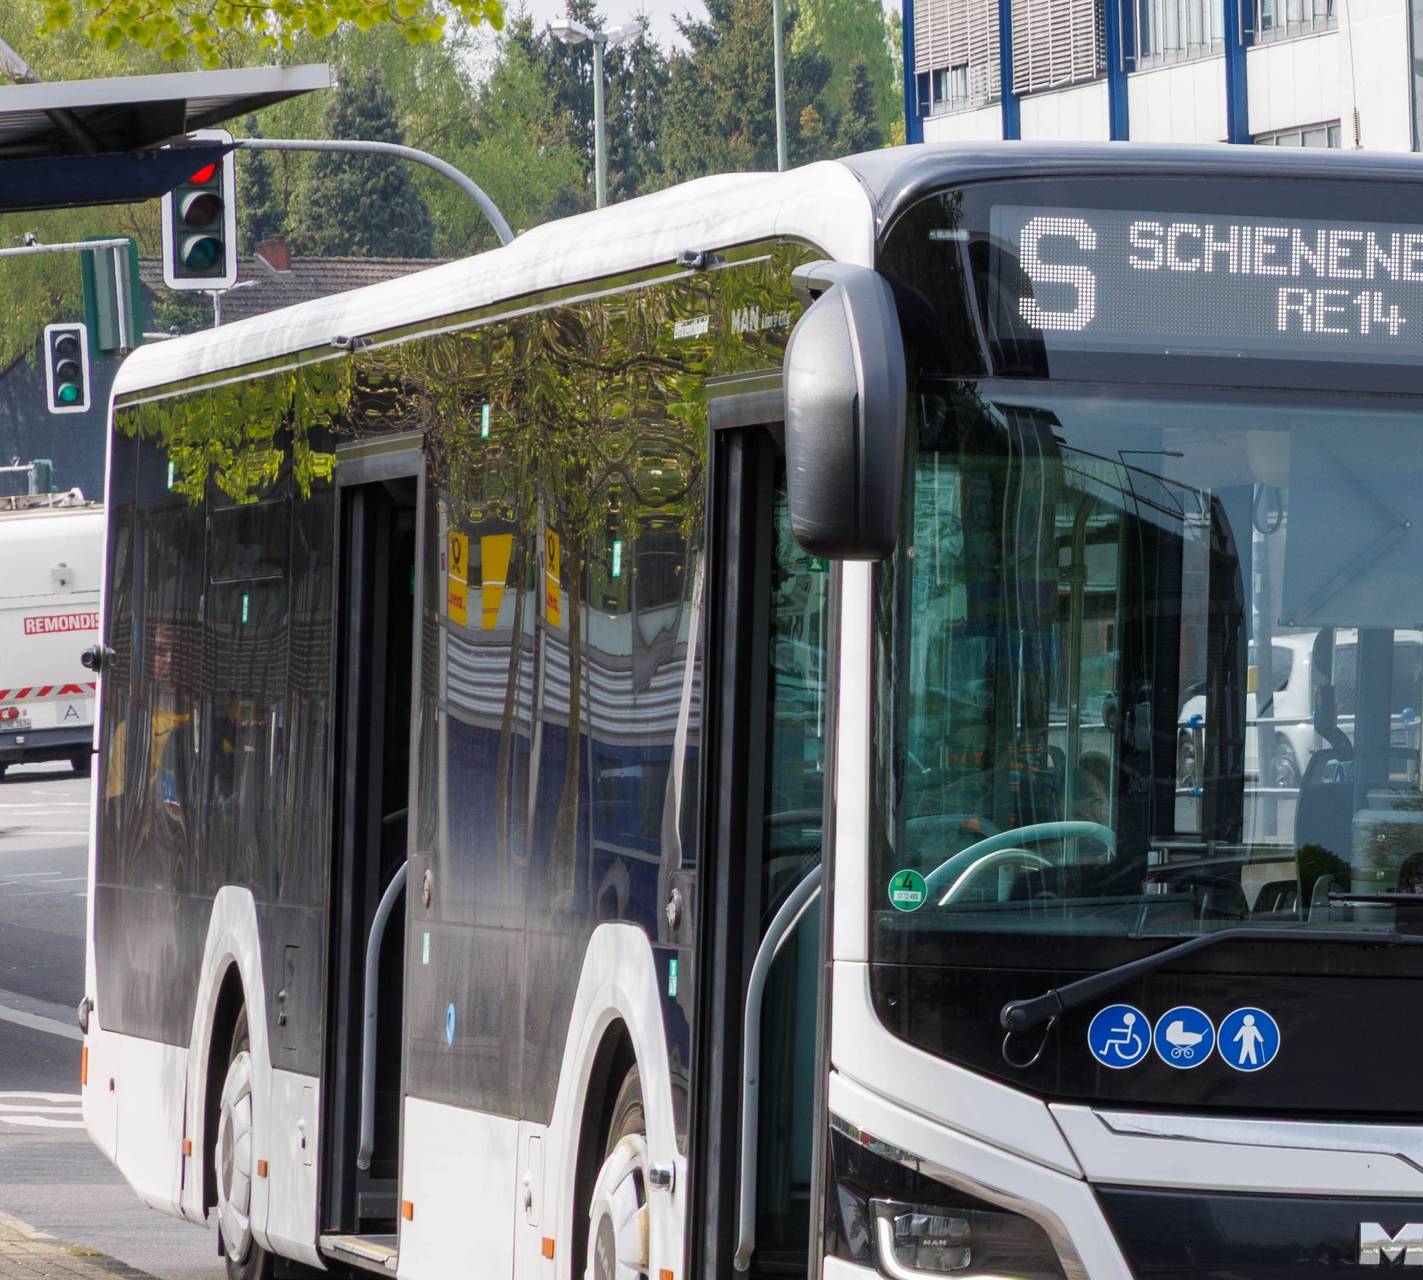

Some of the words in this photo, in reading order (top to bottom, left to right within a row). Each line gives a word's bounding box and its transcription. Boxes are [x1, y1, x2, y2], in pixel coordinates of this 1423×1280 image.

[1019, 216, 1097, 332] S
[731, 305, 760, 335] MAN
[1276, 287, 1408, 336] RE14
[64, 705, 80, 720] A
